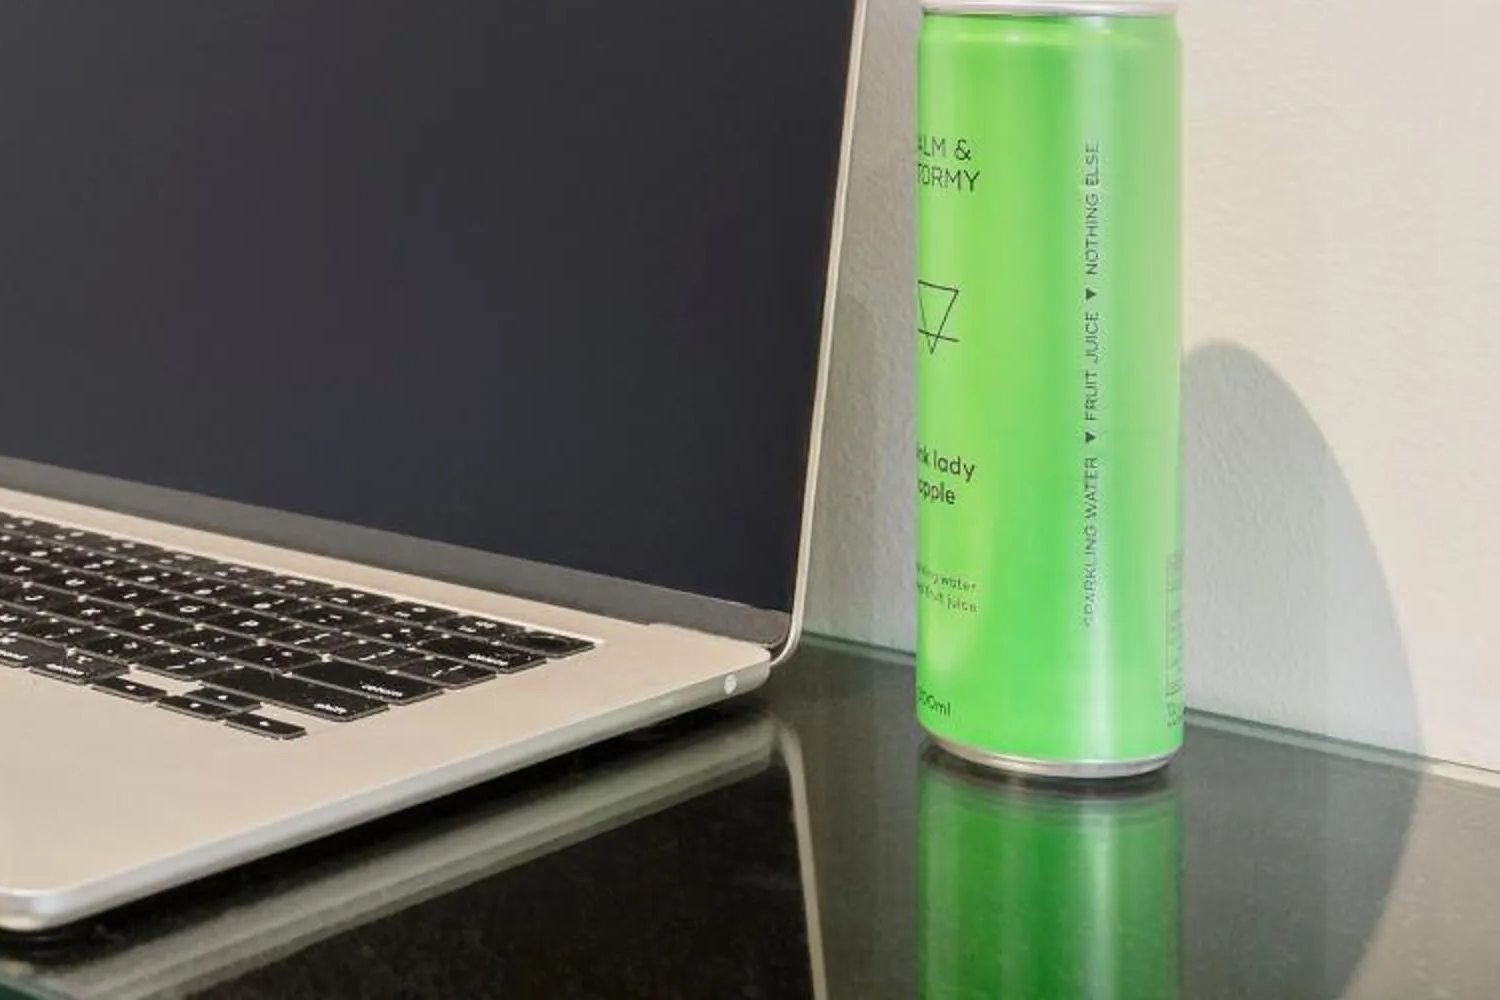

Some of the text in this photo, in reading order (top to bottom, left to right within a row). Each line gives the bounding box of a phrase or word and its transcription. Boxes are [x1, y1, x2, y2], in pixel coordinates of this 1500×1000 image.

[954, 139, 971, 161] &
[1085, 141, 1099, 186] ELSE
[1085, 193, 1099, 275] NOTHING
[1085, 311, 1099, 364] JUICE
[1085, 370, 1098, 421] FRUIT
[933, 449, 975, 483] lady
[1084, 457, 1099, 519] WATER
